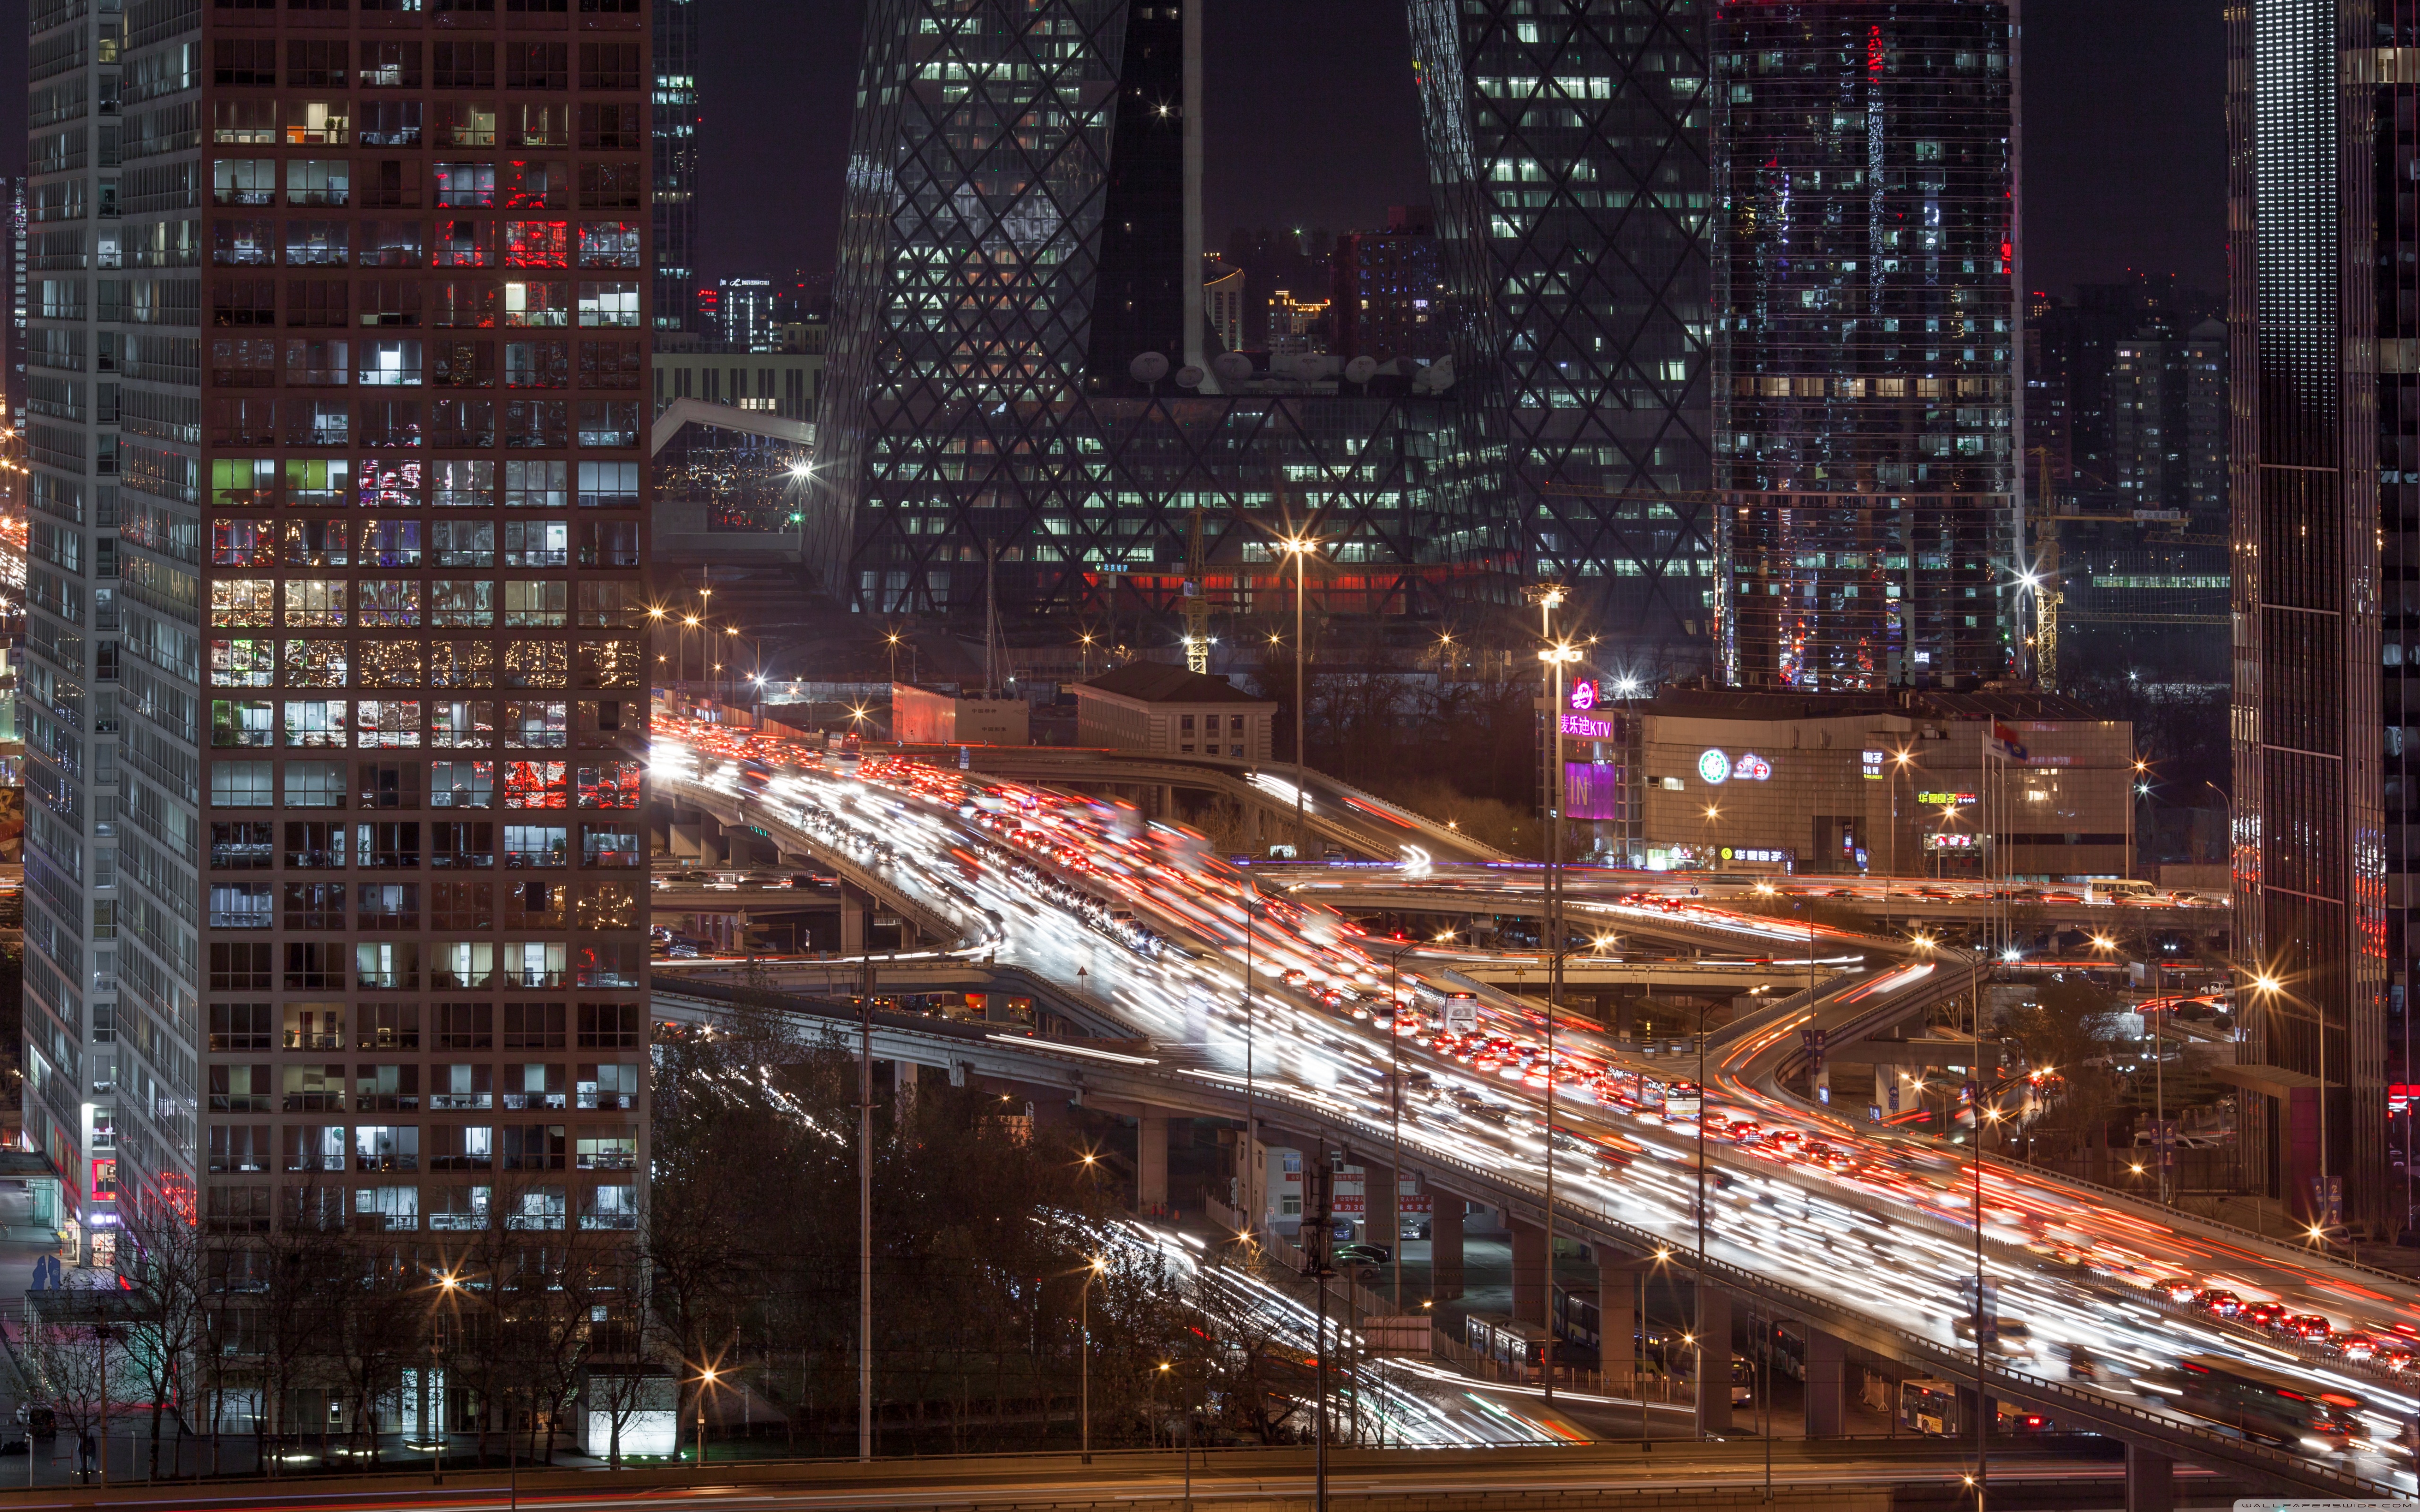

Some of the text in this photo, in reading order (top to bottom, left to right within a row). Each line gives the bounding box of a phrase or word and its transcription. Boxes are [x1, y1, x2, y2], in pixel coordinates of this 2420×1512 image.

[1571, 775, 1587, 806] IN
[1918, 793, 1956, 803] 华夏良子
[1735, 849, 1782, 862] 华夏良子
